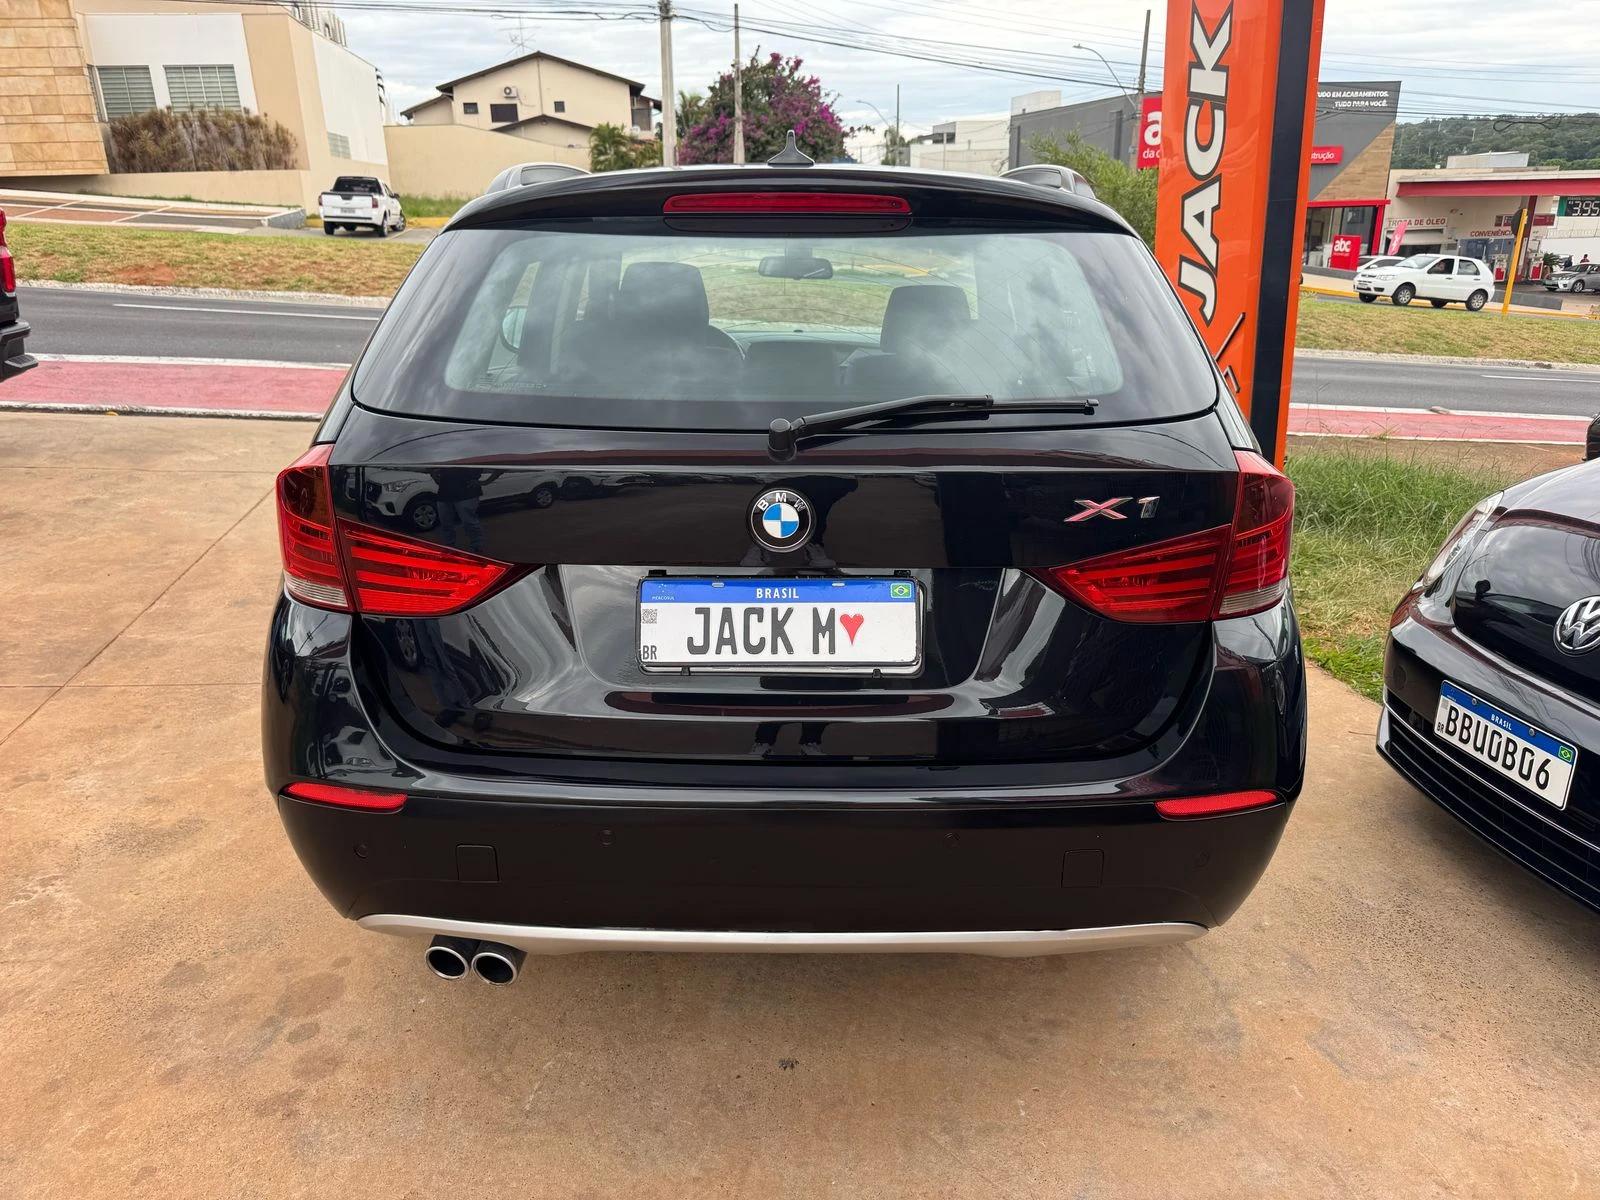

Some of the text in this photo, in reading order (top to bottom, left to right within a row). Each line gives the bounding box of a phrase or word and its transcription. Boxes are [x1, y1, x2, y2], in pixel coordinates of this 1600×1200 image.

[1178, 0, 1233, 327] JACK
[1388, 219, 1412, 227] TROA
[1470, 229, 1512, 237] CONVENIÊNC
[1333, 238, 1352, 253] abc
[757, 492, 806, 512] BMW
[756, 587, 799, 599] BRASIL
[687, 607, 794, 655] JACK
[642, 645, 657, 660] BR
[1436, 721, 1445, 734] BR
[1490, 713, 1512, 731] BRASIL
